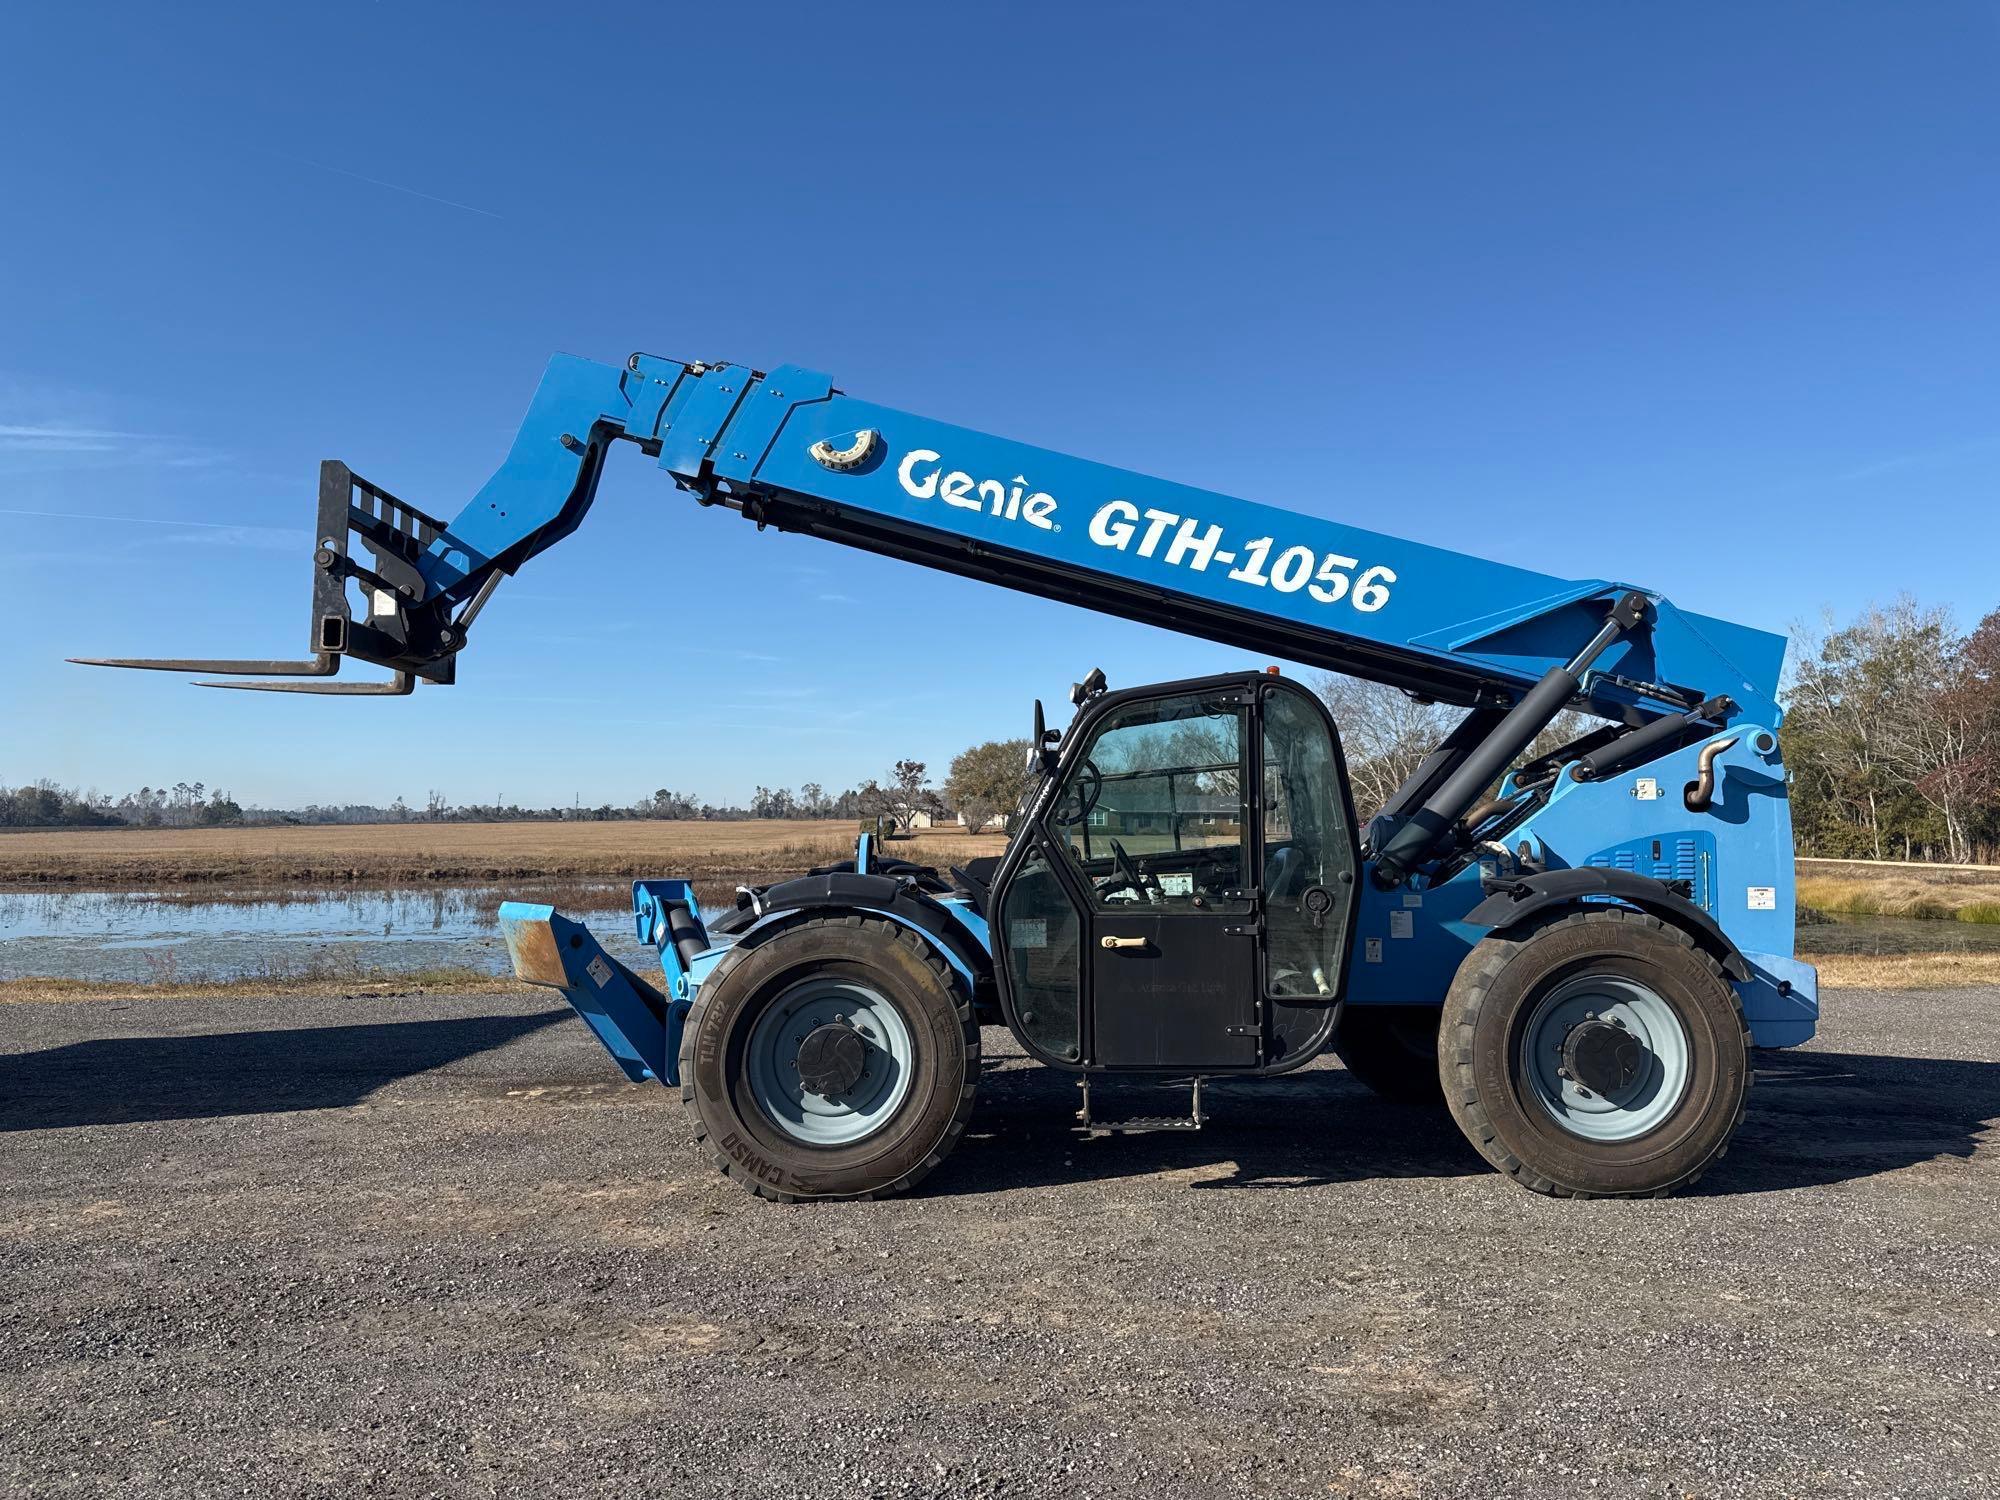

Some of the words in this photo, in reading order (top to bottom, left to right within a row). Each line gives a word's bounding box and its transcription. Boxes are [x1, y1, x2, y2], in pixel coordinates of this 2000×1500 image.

[897, 449, 1058, 530] Genie
[1088, 500, 1397, 612] GTH-1056
[706, 999, 728, 1030] 732
[721, 1132, 784, 1186] CAMSO
